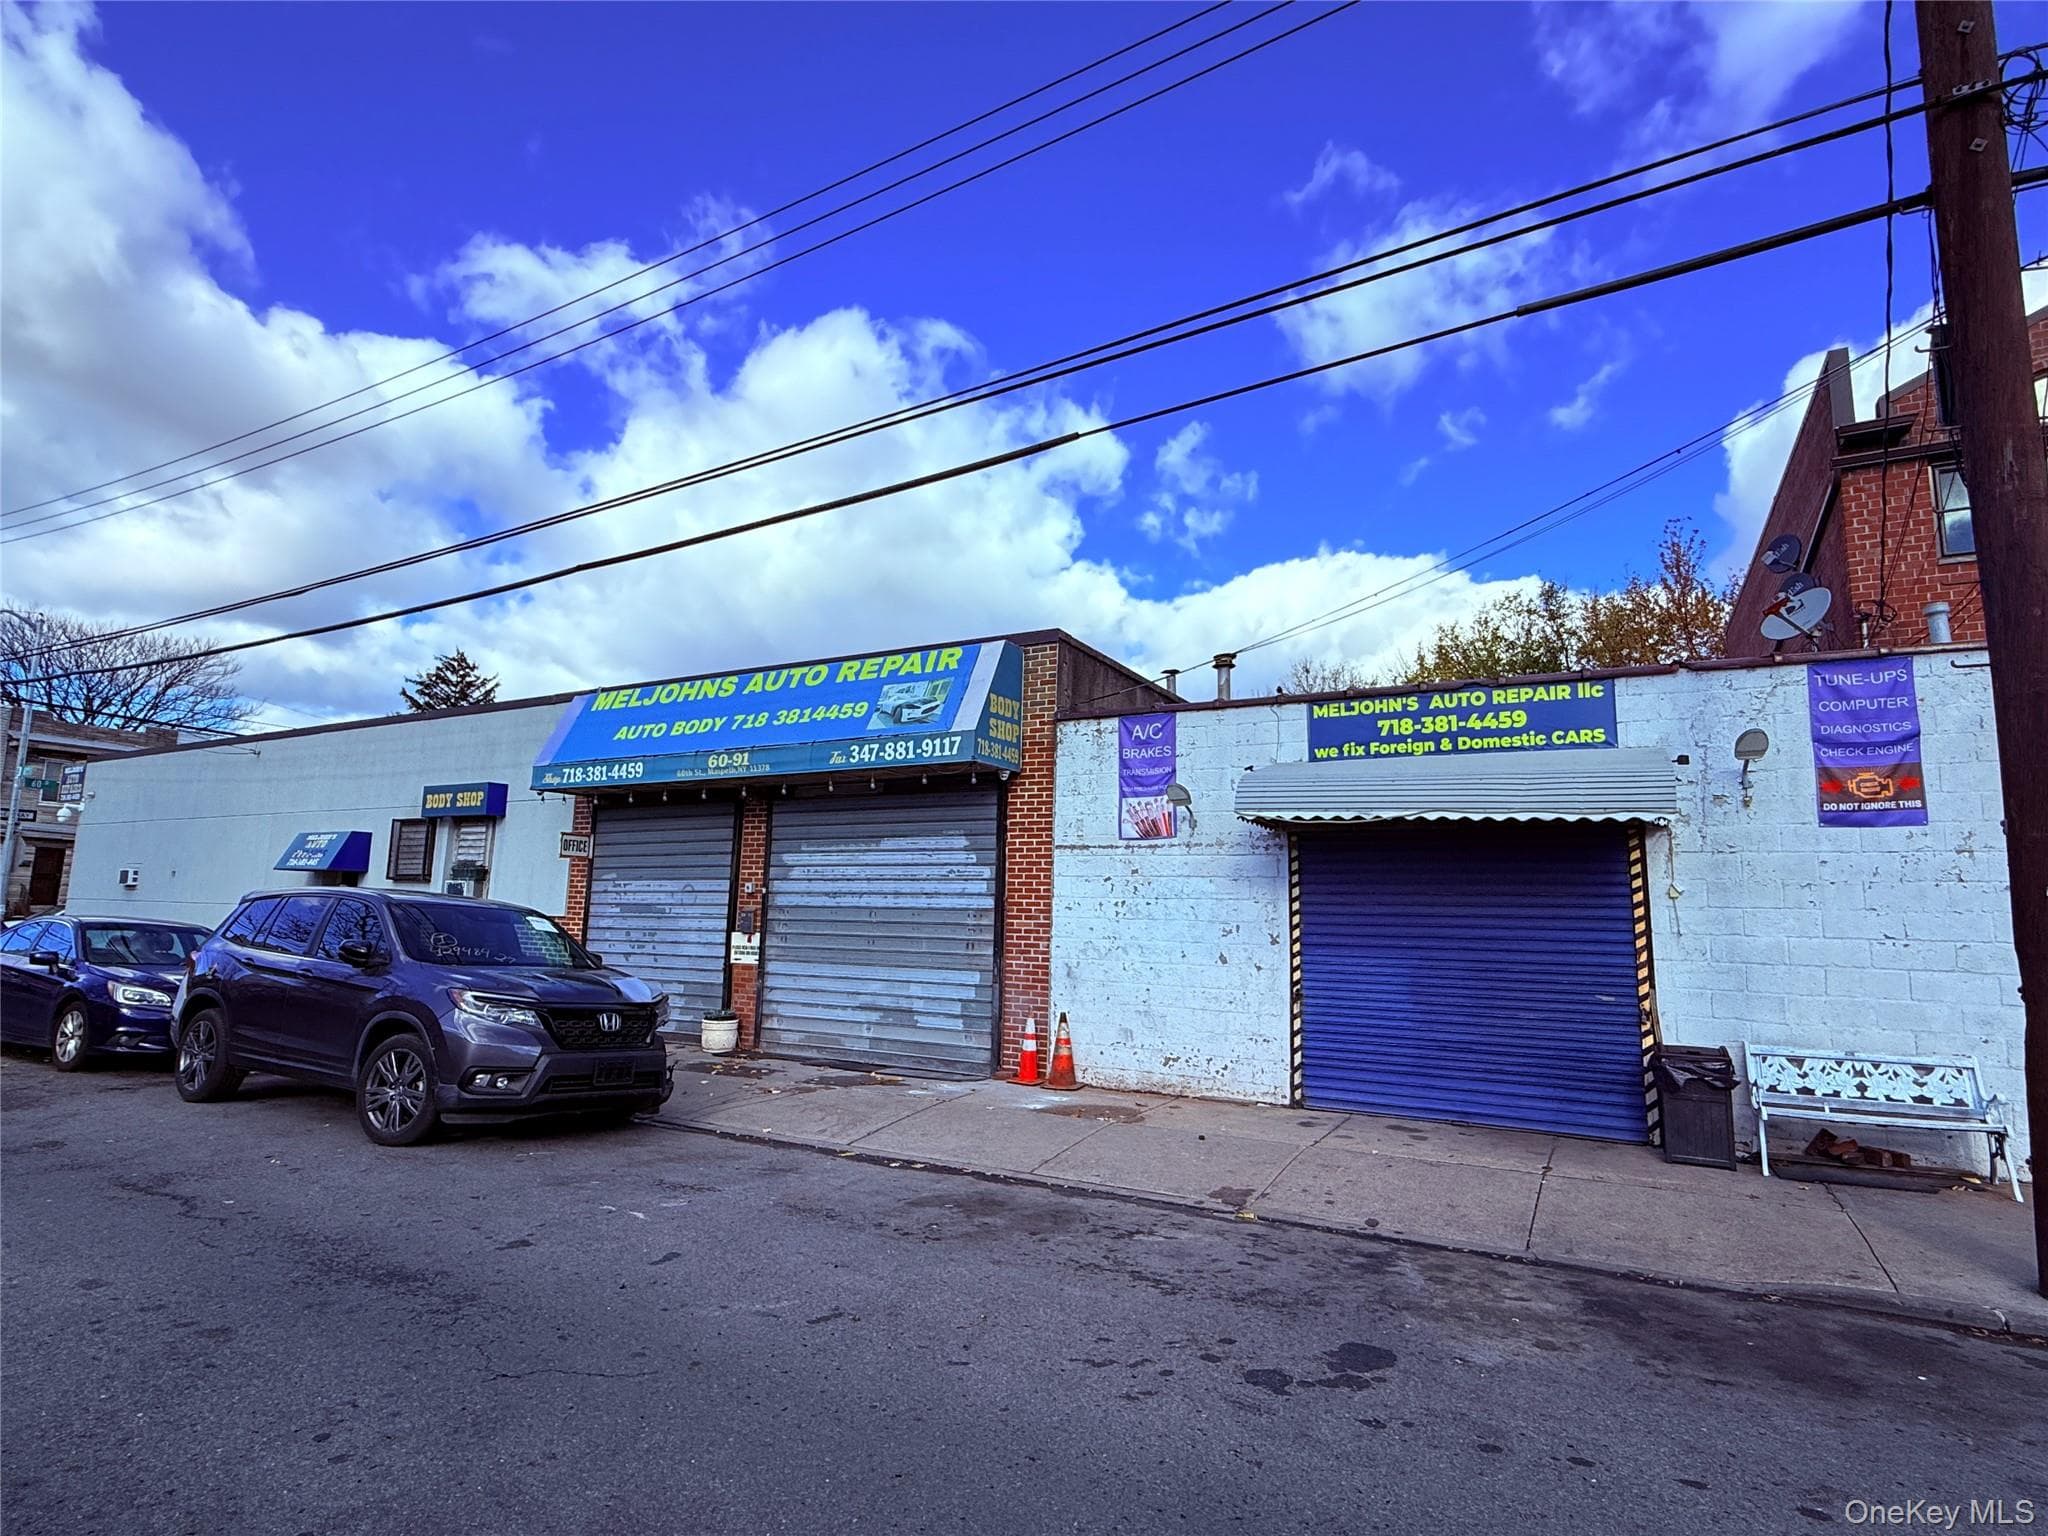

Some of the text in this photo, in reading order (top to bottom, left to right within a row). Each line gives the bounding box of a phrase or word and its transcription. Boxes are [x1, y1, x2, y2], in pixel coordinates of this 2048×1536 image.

[592, 647, 963, 711] MELJOHNS AUTO REPAIR
[1814, 668, 1908, 687] TUNE-UPS
[990, 692, 1020, 720] BODY
[1313, 697, 1418, 719] MELJOHN'S
[1429, 691, 1486, 710] AUTO
[1492, 685, 1571, 705] REPAIR
[1818, 696, 1910, 712] COMPUTER
[613, 701, 869, 741] AUTO BODY 718 3814459
[989, 718, 1019, 743] SHOP
[1377, 710, 1527, 737] 718-381-4459
[1820, 721, 1912, 735] DIAGNOSTICS
[1132, 723, 1162, 740] A/C
[850, 736, 961, 763] 347-881-9117
[1122, 745, 1172, 759] BRAKES
[1314, 728, 1606, 759] we fix Foreign & Domestic CARS
[1820, 742, 1914, 757] CHECK ENGINE
[708, 752, 749, 768] 60-91
[562, 762, 643, 784] 718-381-4459
[425, 791, 484, 808] BODY SHOP
[1823, 799, 1922, 811] DO NOT IGNORE THIS
[563, 838, 588, 853] OFFICE
